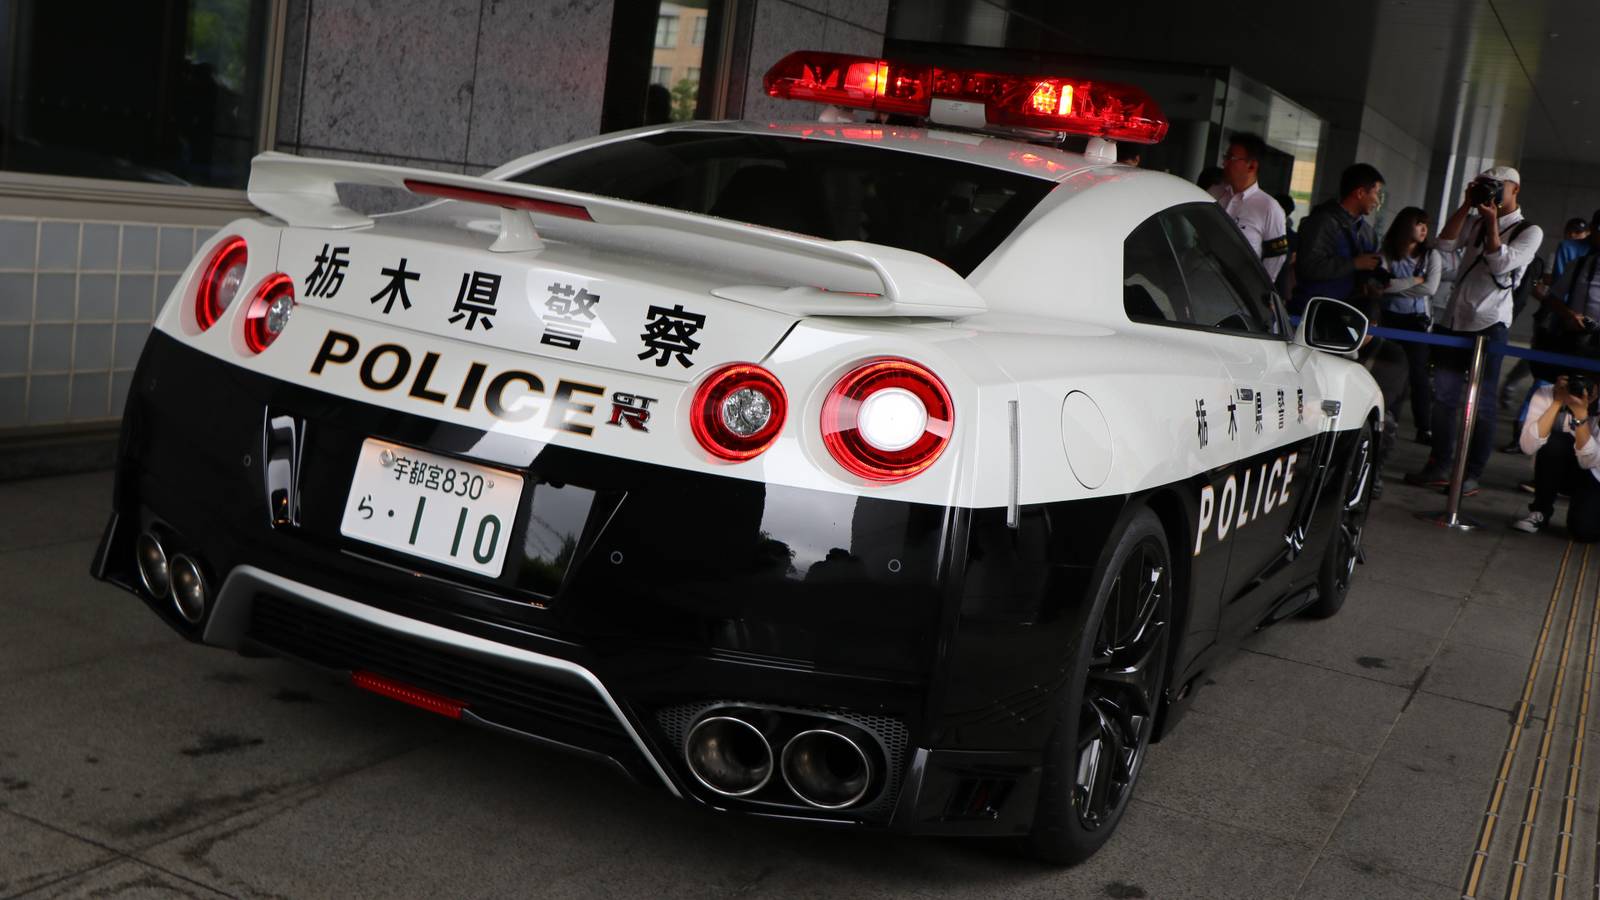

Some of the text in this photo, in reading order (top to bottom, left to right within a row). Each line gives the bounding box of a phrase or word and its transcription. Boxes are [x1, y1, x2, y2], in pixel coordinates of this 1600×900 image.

[304, 243, 706, 369] 栃木県警察
[309, 329, 607, 438] POLICE
[1193, 452, 1298, 556] POLICE
